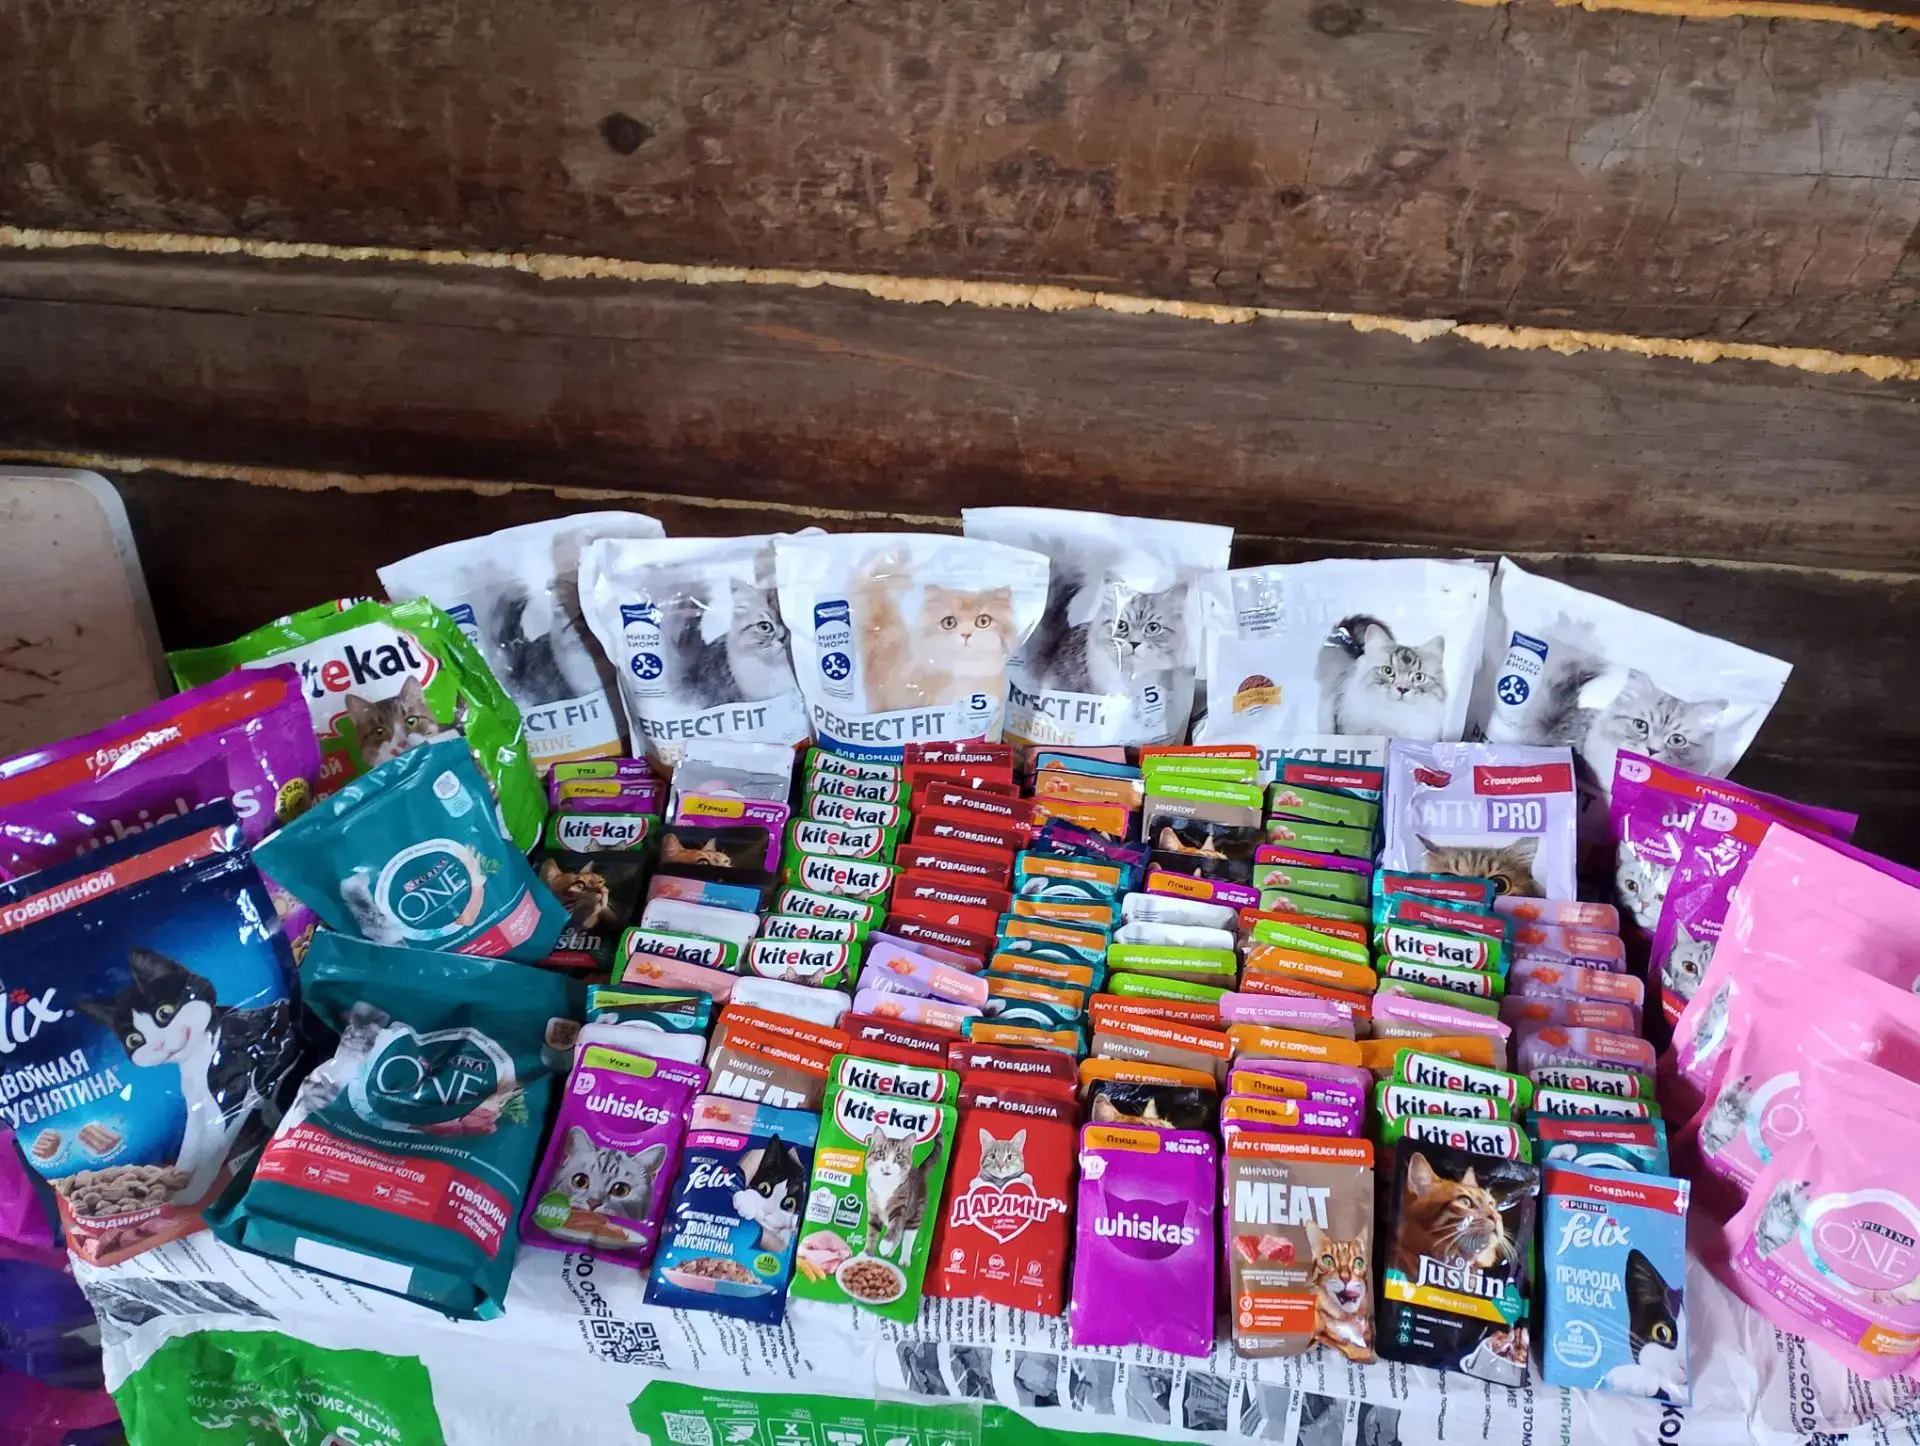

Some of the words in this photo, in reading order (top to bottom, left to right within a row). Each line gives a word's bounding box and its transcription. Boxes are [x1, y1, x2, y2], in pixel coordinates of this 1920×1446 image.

[301, 636, 421, 698] tekat
[970, 694, 988, 710] 5
[1143, 685, 1159, 703] 5
[564, 699, 600, 726] FIT
[638, 711, 726, 741] ERFECT
[732, 707, 767, 731] FIT
[813, 703, 905, 742] PERFECT
[911, 712, 946, 738] FIT
[835, 748, 855, 759] ДЛЯ
[857, 752, 905, 763] ДОМАШ
[942, 753, 993, 763] ГОВЯДИНА
[821, 759, 889, 779] kitekat
[817, 777, 887, 800] kitekat
[816, 801, 887, 825] kitekat
[962, 798, 1012, 816] ГОВЯДИНА
[1155, 804, 1196, 815] МИРАТОРГ
[1492, 800, 1542, 830] PRO
[1710, 810, 1729, 823] 1+
[563, 821, 637, 839] kitekat
[801, 825, 873, 848] kitekat
[953, 830, 1005, 846] ГОВЯДИНА
[807, 861, 881, 888] kitekat
[935, 859, 988, 875] ГОВЯДИНА
[397, 862, 469, 922] ONE
[935, 890, 988, 906] ГОВЯДИНА
[1167, 880, 1195, 893] Птица
[3, 871, 117, 927] ГОВЯДИНОЙ
[787, 894, 860, 920] kitekat
[555, 927, 602, 951] stin
[768, 920, 844, 941] kitekat
[919, 929, 971, 947] ГОВЯДИНА
[635, 938, 712, 965] kitekat
[758, 947, 835, 968] kitekat
[1394, 934, 1474, 964] kitekat
[1094, 1003, 1112, 1011] РАГУ
[1119, 1005, 1165, 1017] ГОВЯДИНОЙ
[1165, 1010, 1189, 1020] BLACK
[1189, 1012, 1216, 1022] ANGUS
[795, 1029, 818, 1044] BLACK
[818, 1036, 844, 1051] ANGUS
[883, 1033, 940, 1053] ГОВЯДИНА
[1101, 1018, 1120, 1030] РАГУ
[1127, 1023, 1173, 1041] ГОВЯДИНОЙ
[1173, 1032, 1199, 1046] BLACK
[1199, 1037, 1225, 1050] ANGUS
[1259, 1038, 1279, 1050] РАГУ
[731, 1036, 750, 1048] РАГУ
[800, 1055, 823, 1069] BLACK
[1103, 1041, 1150, 1058] МИРАТОРГ
[727, 1059, 775, 1078] МИРАТОРГ
[992, 1058, 1052, 1074] ГОВЯДИНА
[376, 1055, 482, 1105] ONE
[849, 1066, 931, 1098] kitekat
[1254, 1080, 1284, 1094] Птица
[1416, 1062, 1502, 1097] kitekat
[1537, 1071, 1625, 1097] kitekat
[0, 1067, 123, 1130] УСНЯТИНА
[585, 1092, 671, 1125] whiskas
[998, 1101, 1058, 1119] ГОВЯДИНА
[843, 1097, 928, 1133] kitekat
[1245, 1104, 1277, 1117] Птица
[292, 1127, 316, 1142] ДЛЯ
[1106, 1134, 1138, 1147] Птица
[1416, 1125, 1506, 1157] kitekat
[410, 1143, 472, 1160] ИММУНИТЕТ
[1232, 1140, 1253, 1150] РАГУ
[1260, 1142, 1310, 1155] ГОВЯДИНОЙ
[1310, 1145, 1337, 1157] BLACK
[1337, 1148, 1366, 1159] ANGUS
[307, 1141, 396, 1174] КАСТРИРОВАННЫХ
[394, 1166, 427, 1184] КОТОВ
[1239, 1166, 1290, 1179] МИРАТОРГ
[683, 1163, 736, 1195] felix
[823, 1171, 848, 1183] СОУСЕ
[1588, 1183, 1647, 1200] ГОВЯДИНА
[448, 1180, 508, 1232] ГОВЯДИНА
[950, 1194, 1054, 1228] ДАРЛИНГ
[1233, 1180, 1331, 1229] MEAT
[1569, 1201, 1607, 1213] PURINA
[76, 1206, 161, 1230] овядиной
[683, 1220, 730, 1239] ДВОЙНАЯ
[1094, 1212, 1195, 1246] whiskas
[1556, 1212, 1632, 1256] felix
[1860, 1220, 1916, 1248] PURINA
[673, 1235, 735, 1257] ВКУСНЯТИНА
[1819, 1222, 1914, 1280] ONE
[1415, 1254, 1505, 1300] Justin
[1556, 1265, 1622, 1292] ПРИРОДА
[1565, 1285, 1613, 1310] ВКУСА
